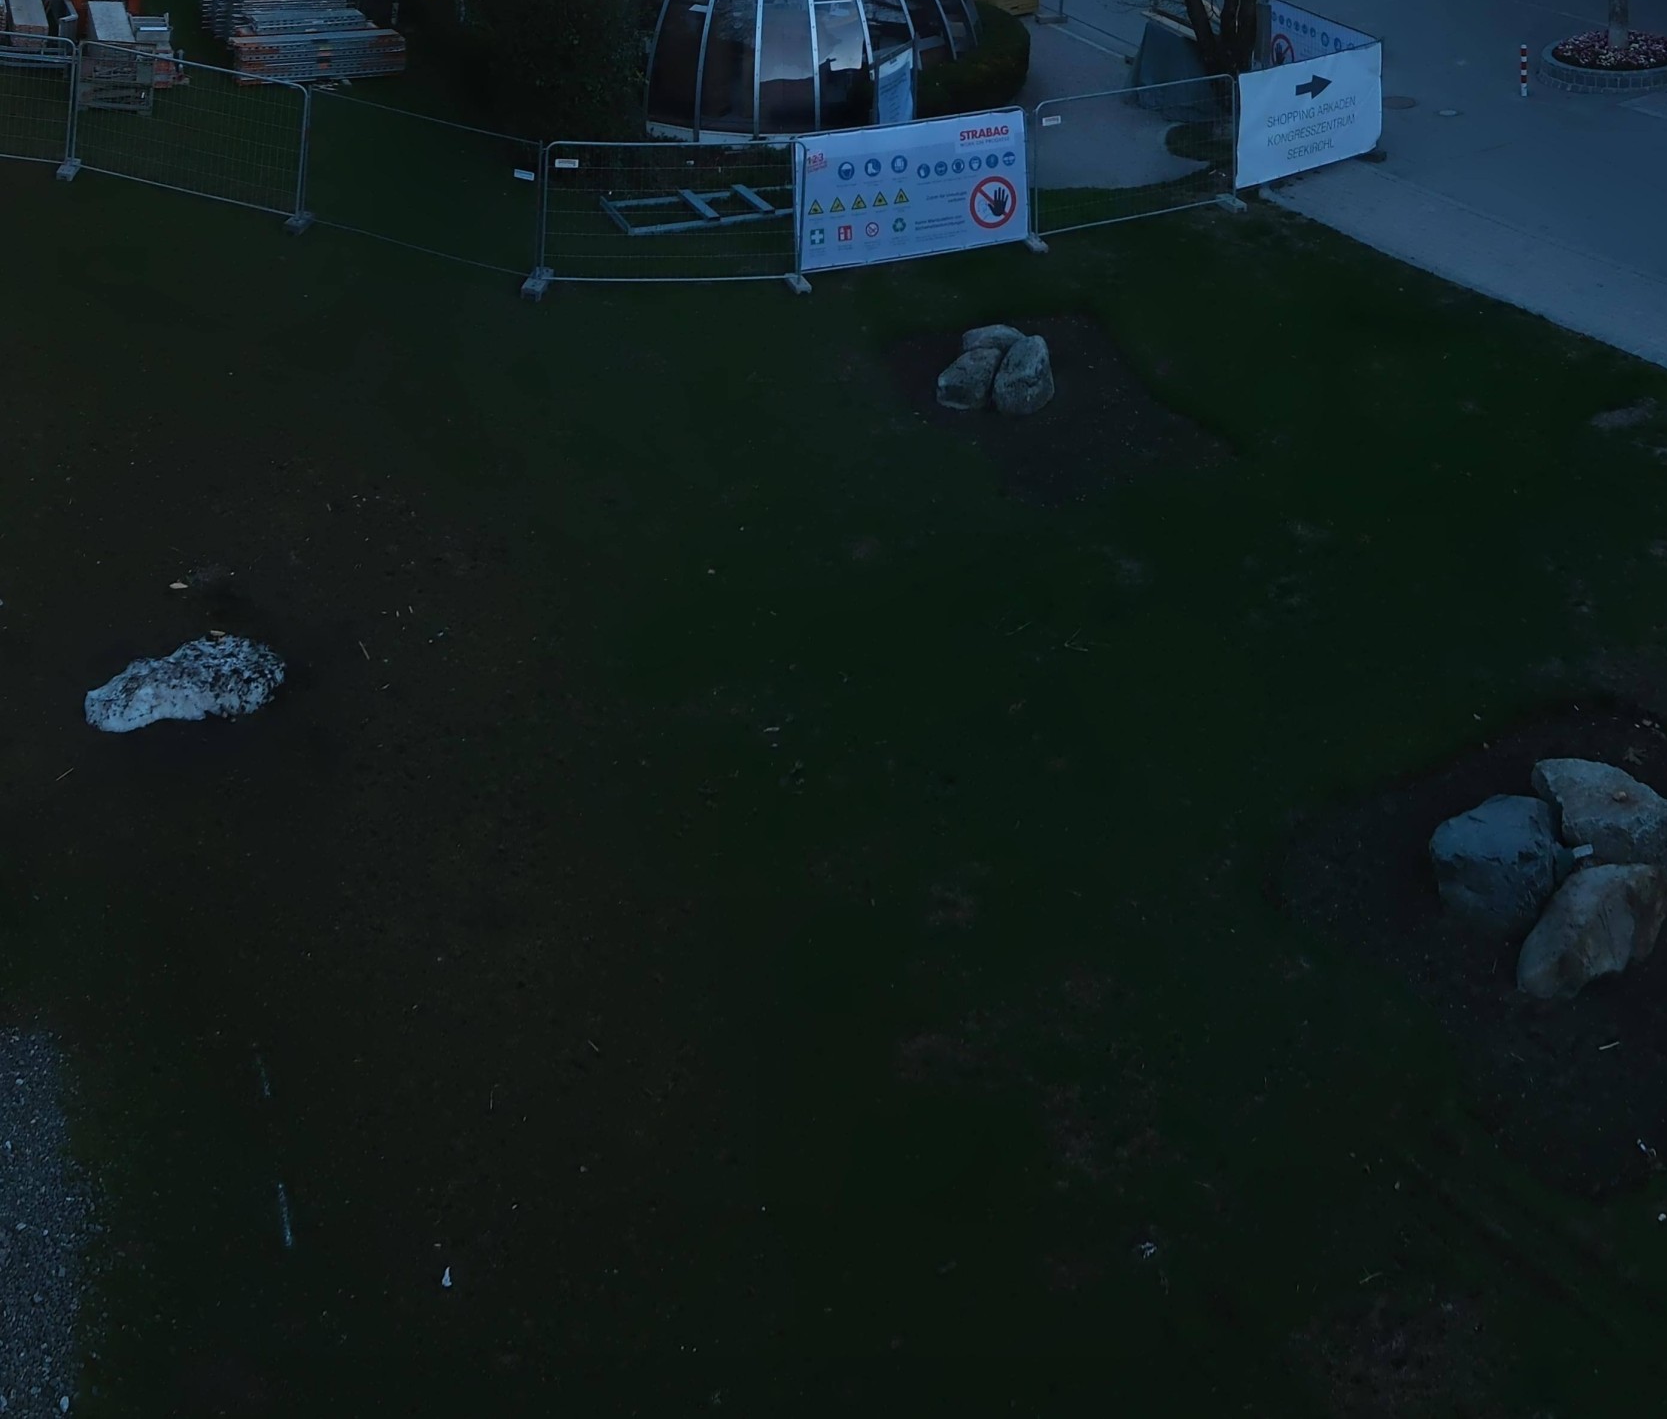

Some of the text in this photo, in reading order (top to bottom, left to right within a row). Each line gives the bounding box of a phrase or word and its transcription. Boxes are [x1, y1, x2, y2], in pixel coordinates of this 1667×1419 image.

[1267, 96, 1356, 128] SHOPPING ARKADEN
[960, 125, 1009, 141] STRABAG
[1267, 113, 1355, 146] KONGRESSZENTRUM
[1287, 138, 1335, 160] SEEKIRCHL
